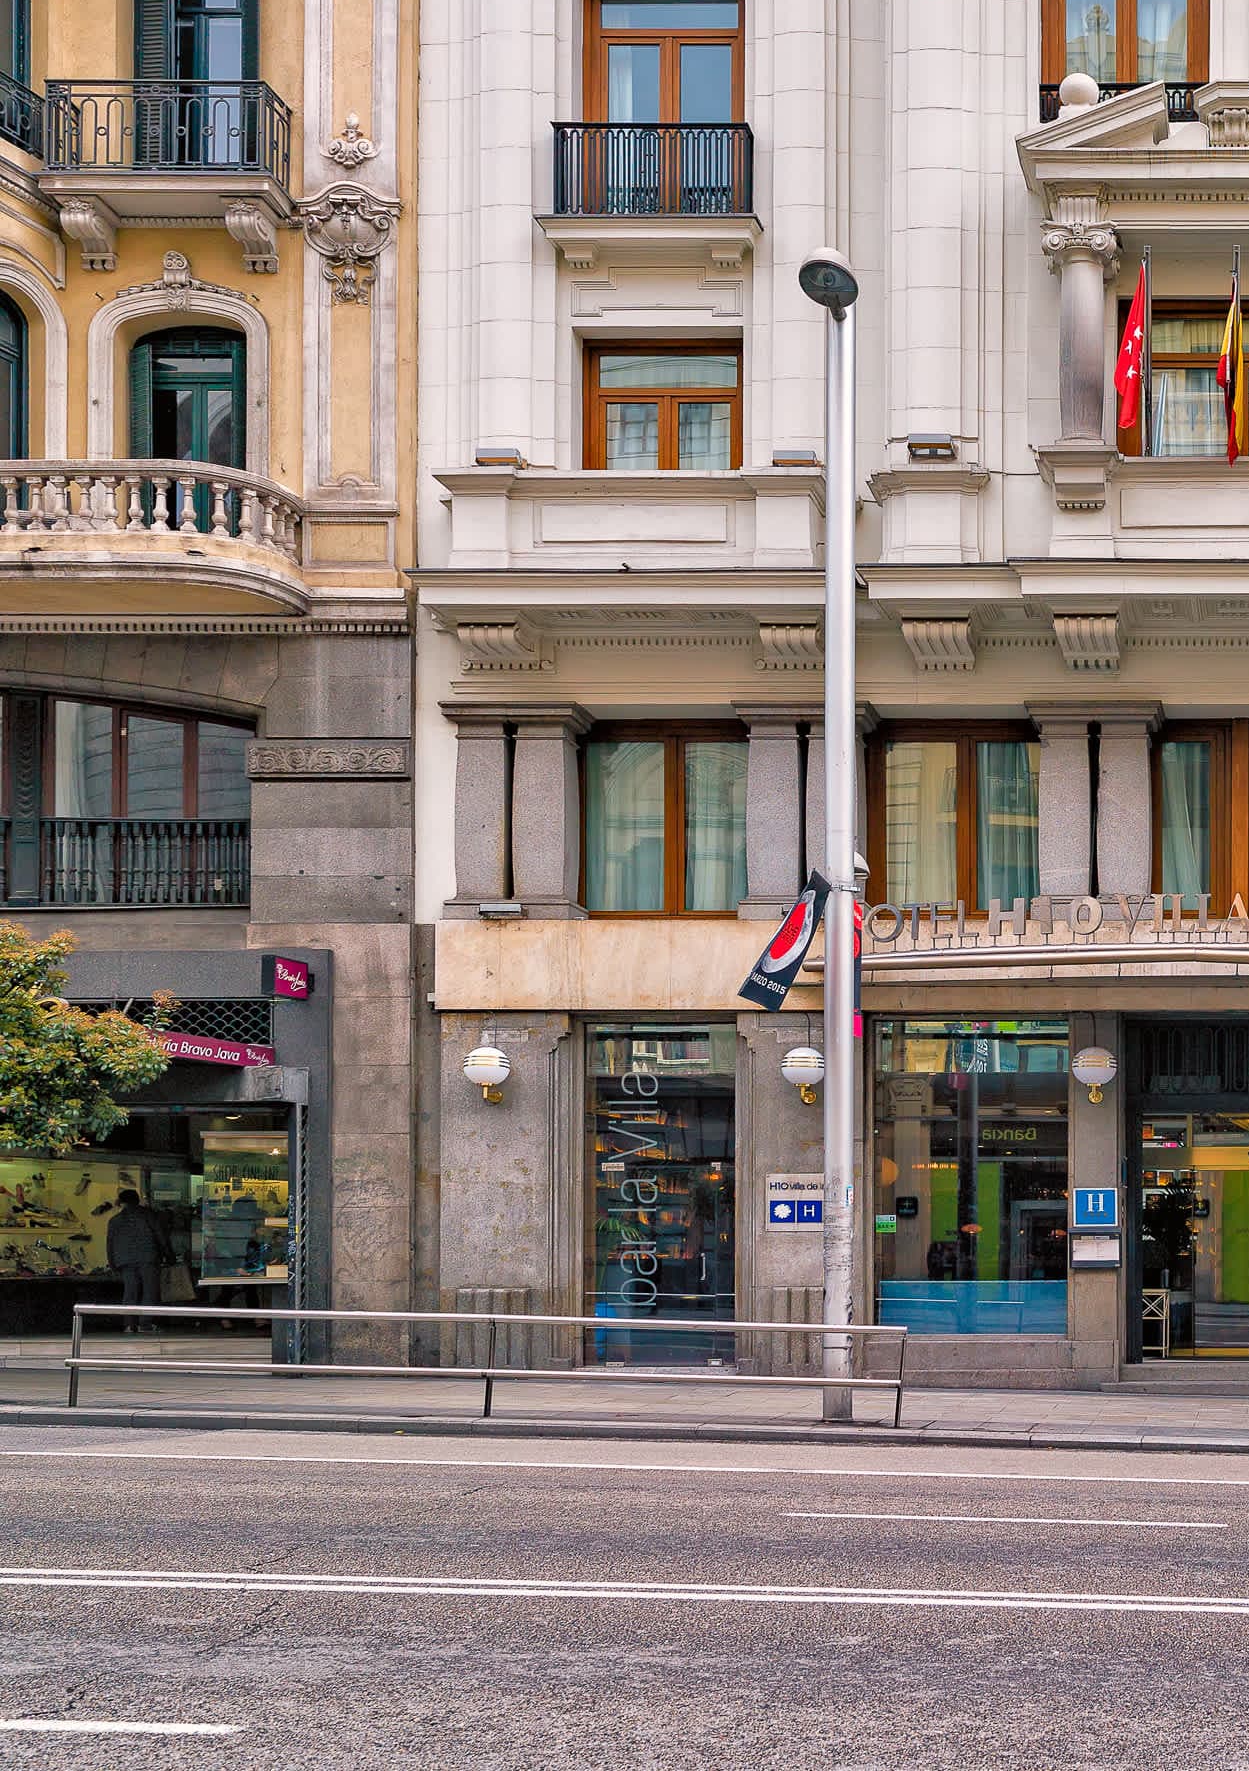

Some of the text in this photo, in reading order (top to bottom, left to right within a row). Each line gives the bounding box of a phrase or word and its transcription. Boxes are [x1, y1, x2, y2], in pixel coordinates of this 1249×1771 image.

[865, 900, 979, 943] OTEL
[767, 980, 787, 995] 2015
[180, 1041, 213, 1057] Bravo
[213, 1047, 241, 1062] Java
[607, 1071, 659, 1161] Villa
[607, 1175, 658, 1212] la
[769, 1182, 789, 1190] H10
[806, 1182, 818, 1190] de
[803, 1204, 815, 1217] H
[1086, 1193, 1105, 1212] H
[607, 1229, 658, 1306] bar
